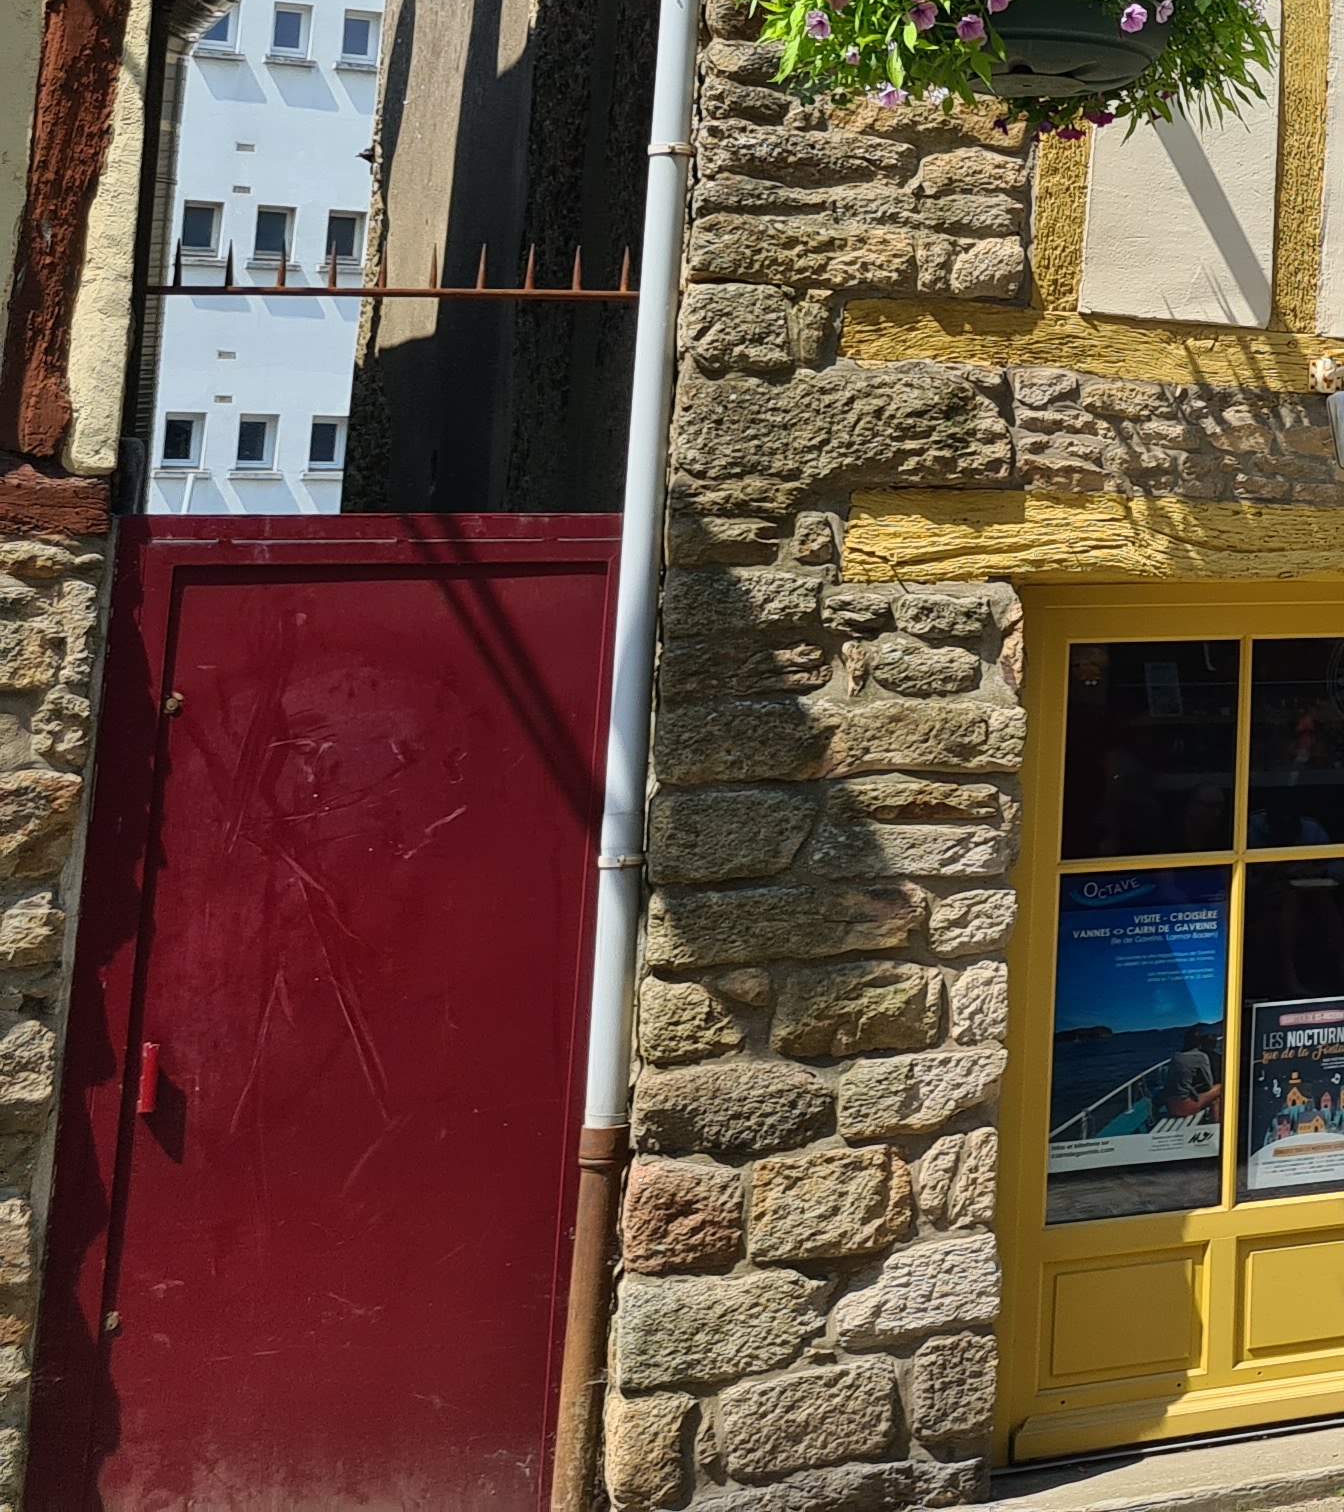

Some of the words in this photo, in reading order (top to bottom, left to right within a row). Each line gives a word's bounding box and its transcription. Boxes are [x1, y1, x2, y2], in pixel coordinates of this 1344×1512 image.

[1083, 877, 1141, 899] OCTAVE
[1133, 914, 1161, 924] VISITE
[1169, 909, 1219, 922] CROISIÈRE
[1072, 928, 1110, 939] VANNES
[1126, 926, 1156, 936] CAIRN
[1157, 924, 1170, 933] DE
[1174, 921, 1218, 932] GAVRINIS
[1262, 1032, 1284, 1050] LES
